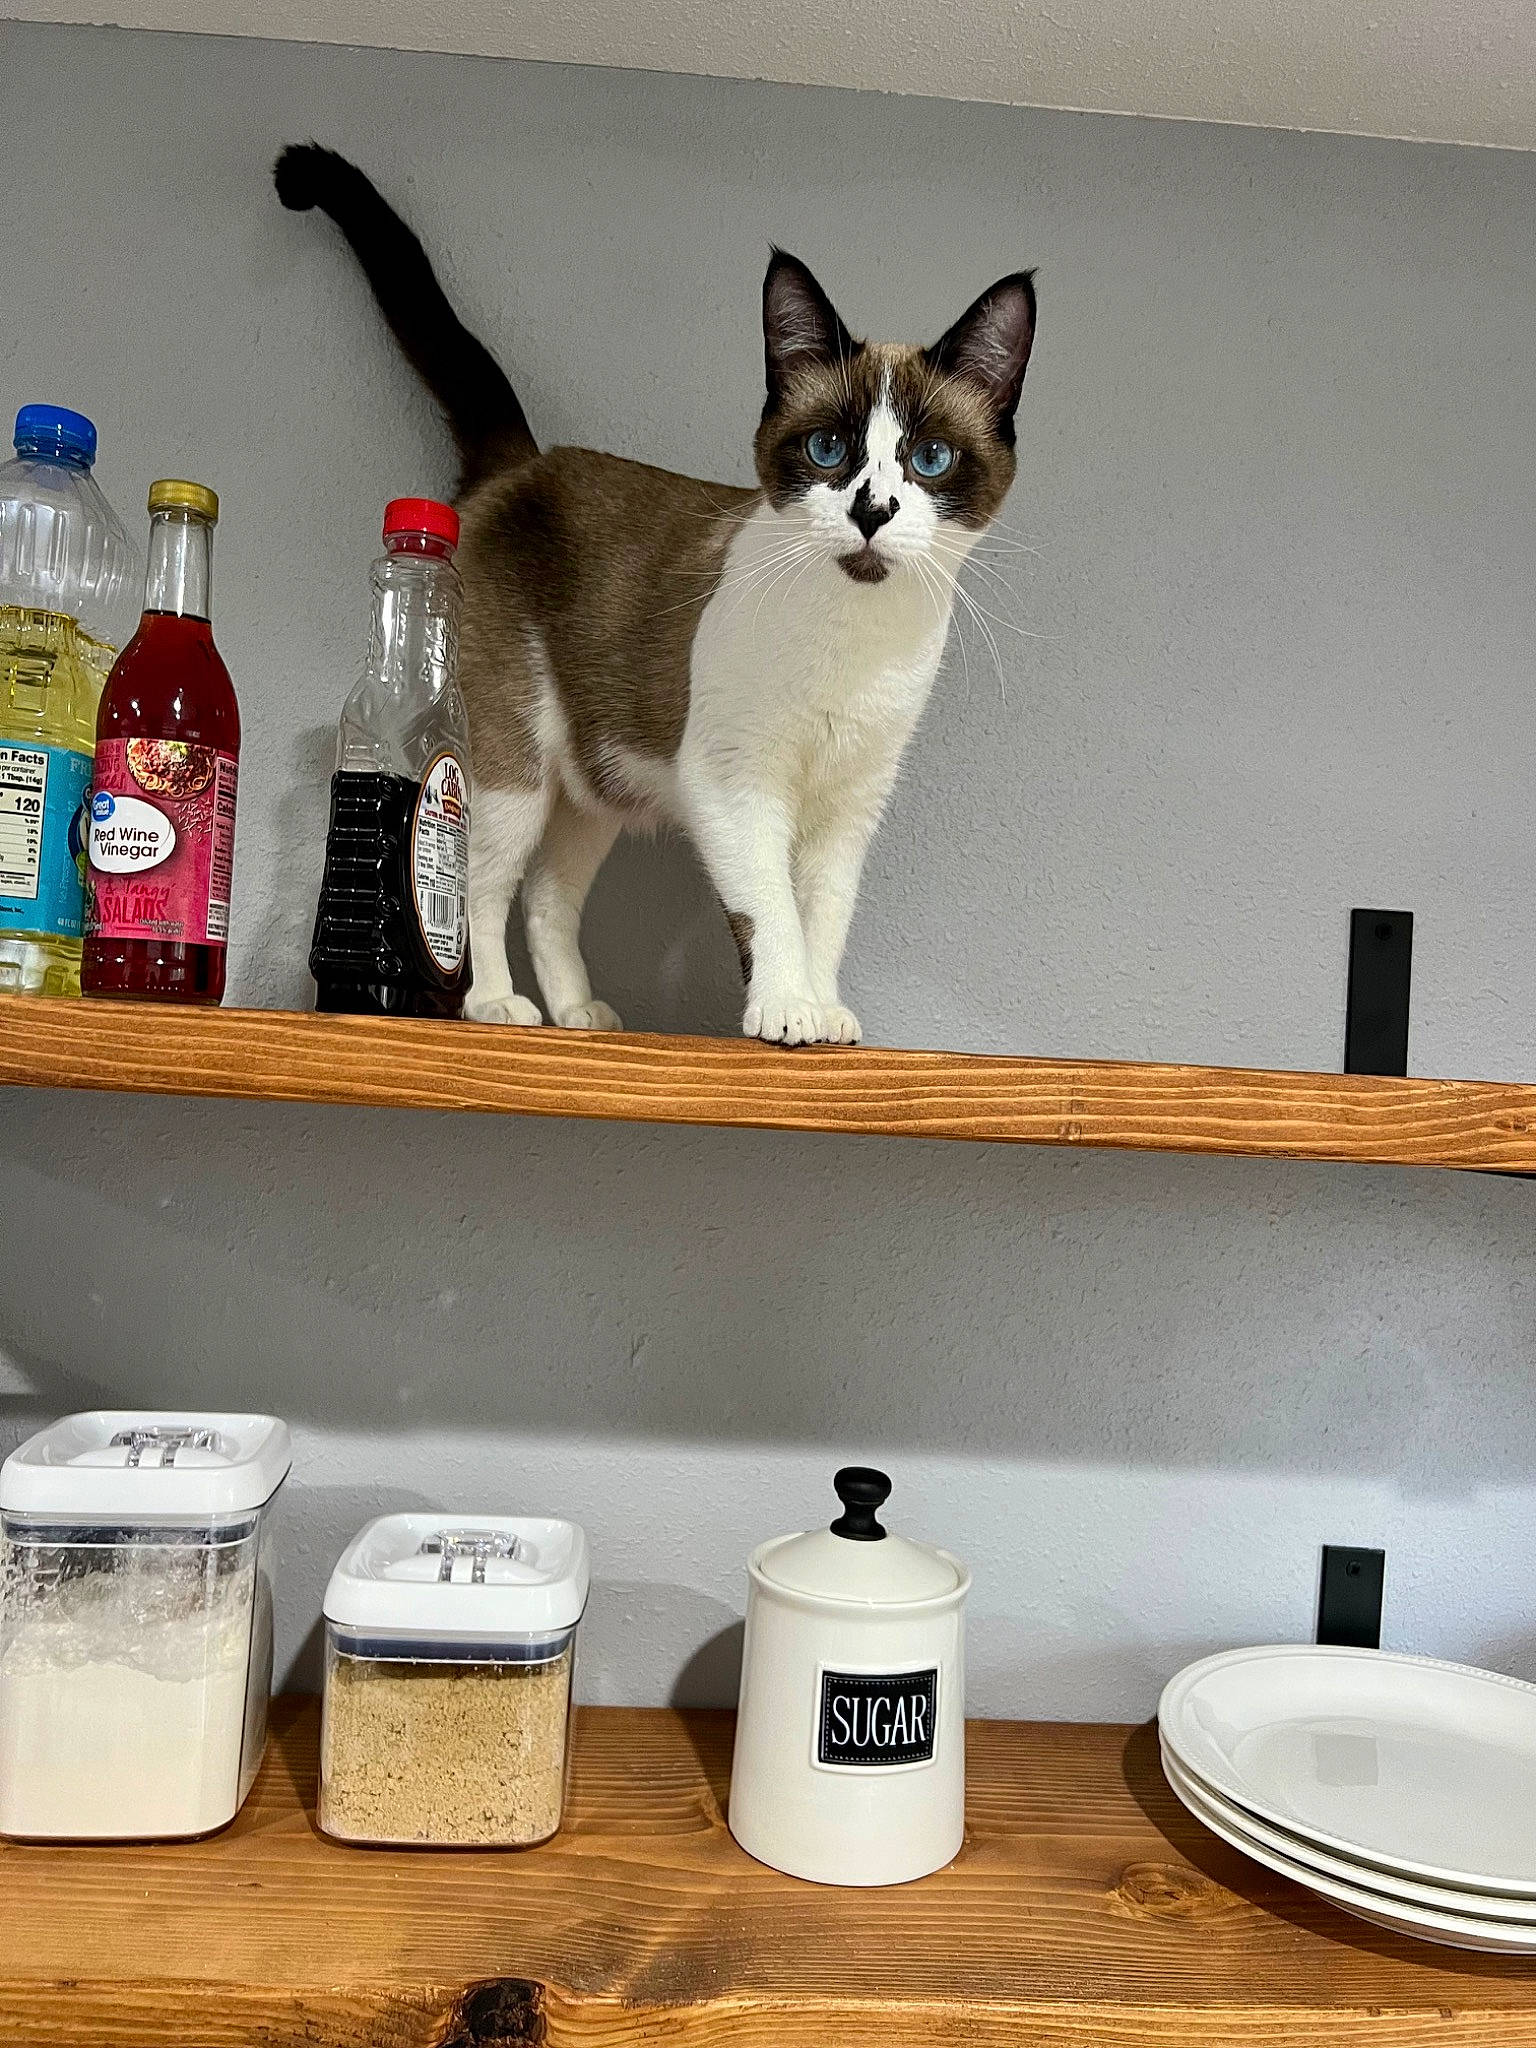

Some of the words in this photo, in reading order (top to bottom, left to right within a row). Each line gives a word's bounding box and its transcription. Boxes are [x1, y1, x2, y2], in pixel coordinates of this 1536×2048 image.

[11, 750, 45, 766] Facts
[444, 762, 459, 784] LOG
[15, 796, 41, 813] 120
[93, 799, 110, 811] Great
[94, 827, 116, 843] Red
[119, 827, 160, 843] Wine
[99, 842, 160, 860] Vinegar
[103, 896, 168, 923] SALADS
[831, 1694, 927, 1747] SUGAR
